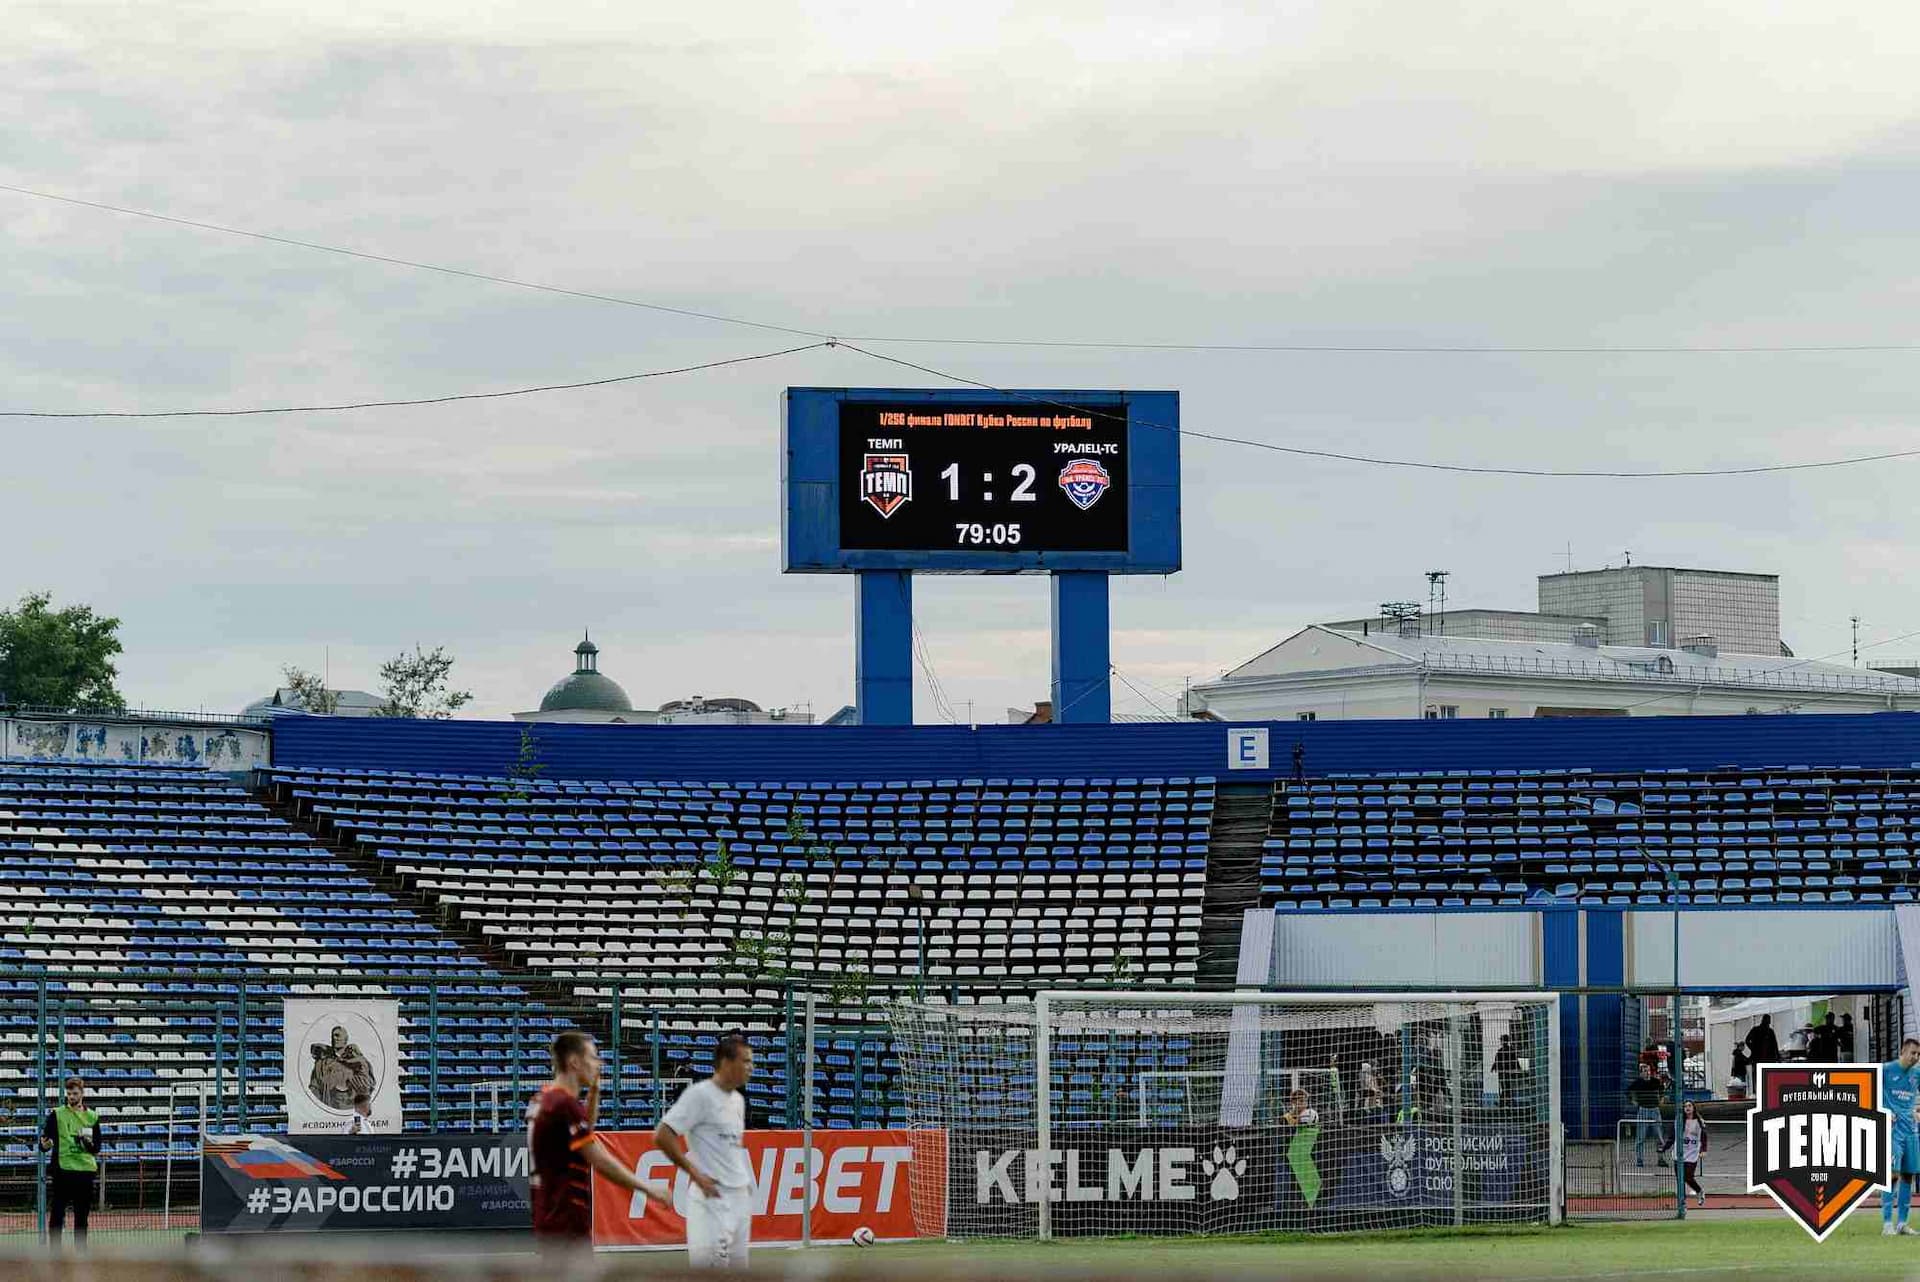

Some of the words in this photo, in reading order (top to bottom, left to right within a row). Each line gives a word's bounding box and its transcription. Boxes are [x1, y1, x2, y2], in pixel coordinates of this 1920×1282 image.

[879, 413, 905, 426] 1/256
[907, 413, 943, 428] финала
[977, 414, 1004, 429] Кубка
[1006, 414, 1038, 428] России
[1053, 414, 1092, 430] футболу
[867, 439, 903, 449] ТЕМП
[1054, 443, 1119, 455] УРАЛЕЦ-ТС
[866, 471, 907, 494] ТЕМП
[941, 463, 959, 500] 1
[1010, 463, 1036, 501] 2
[956, 523, 1021, 544] 79:05
[391, 1147, 529, 1179] #ЗАМИ
[976, 1148, 1196, 1204] KELME
[1425, 1176, 1458, 1191] СОЮ
[247, 1185, 455, 1214] #ЗАРОССИЮ
